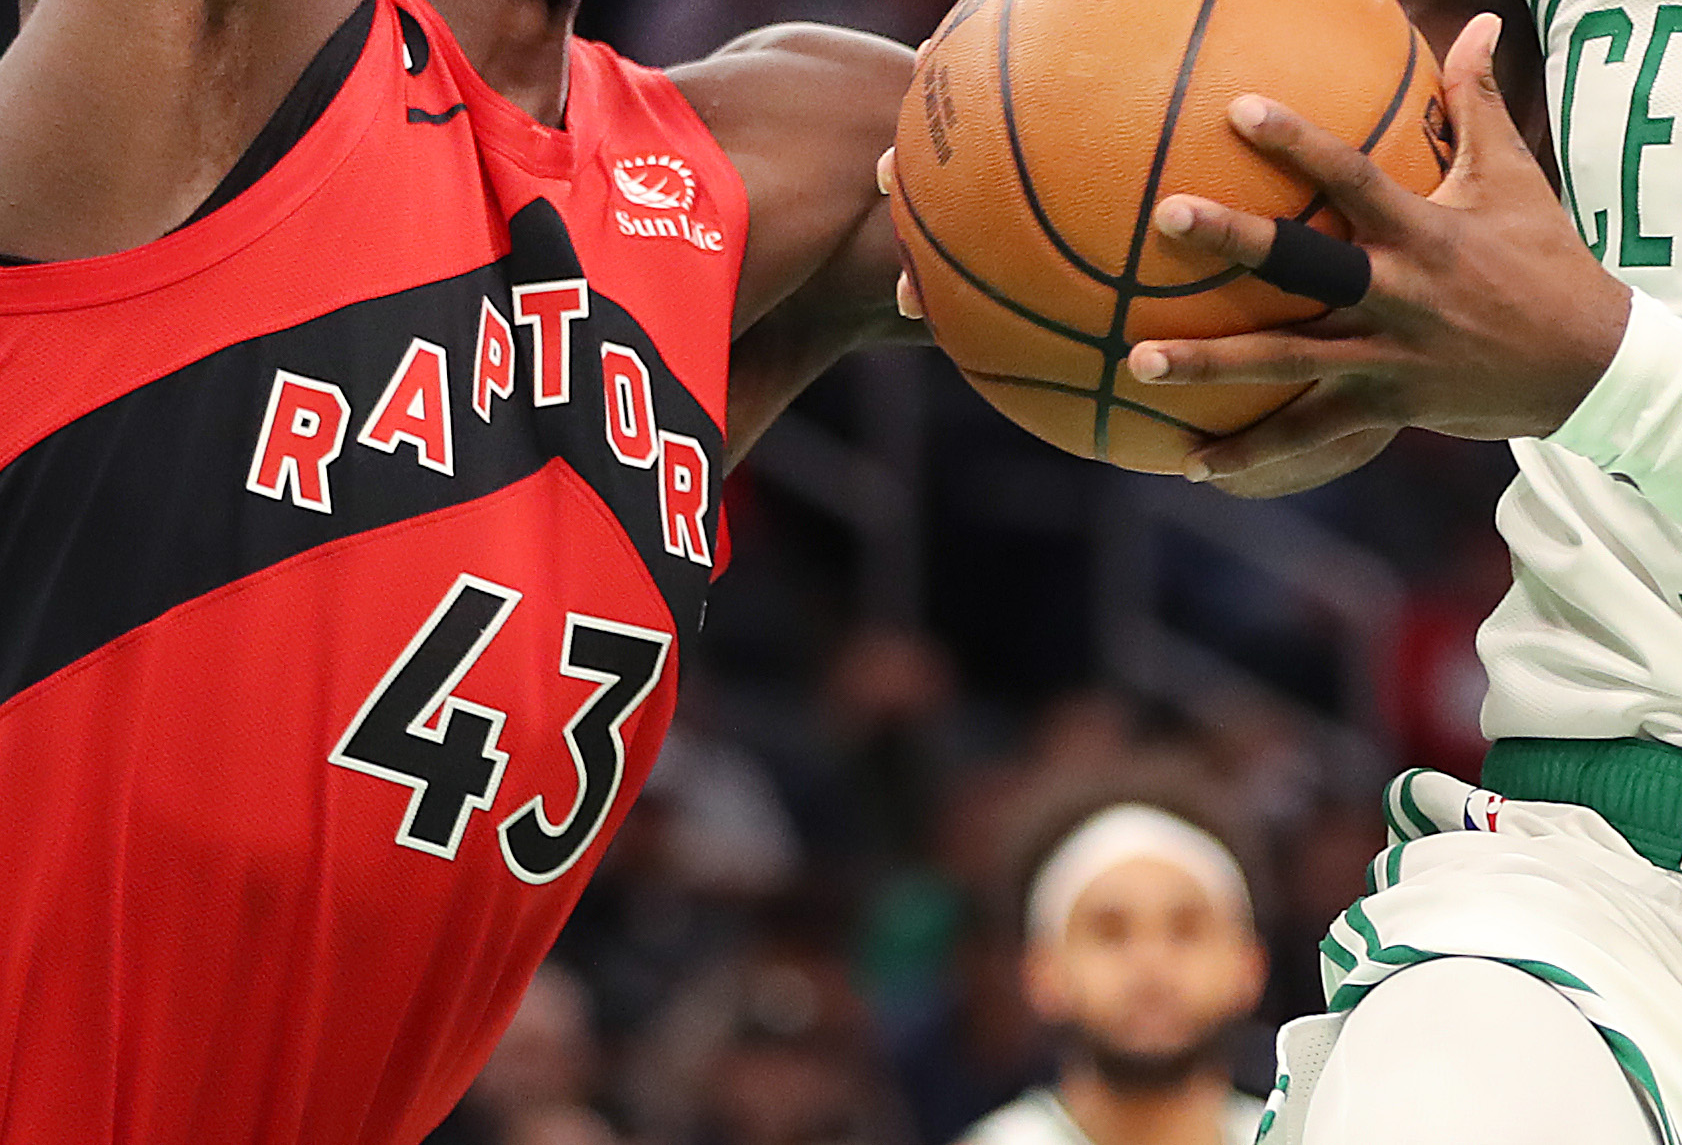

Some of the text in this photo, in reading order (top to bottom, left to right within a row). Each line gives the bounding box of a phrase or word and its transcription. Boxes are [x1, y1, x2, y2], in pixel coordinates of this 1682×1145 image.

[615, 210, 678, 237] Sun
[246, 277, 713, 569] RAPTOR
[327, 572, 673, 885] 43
